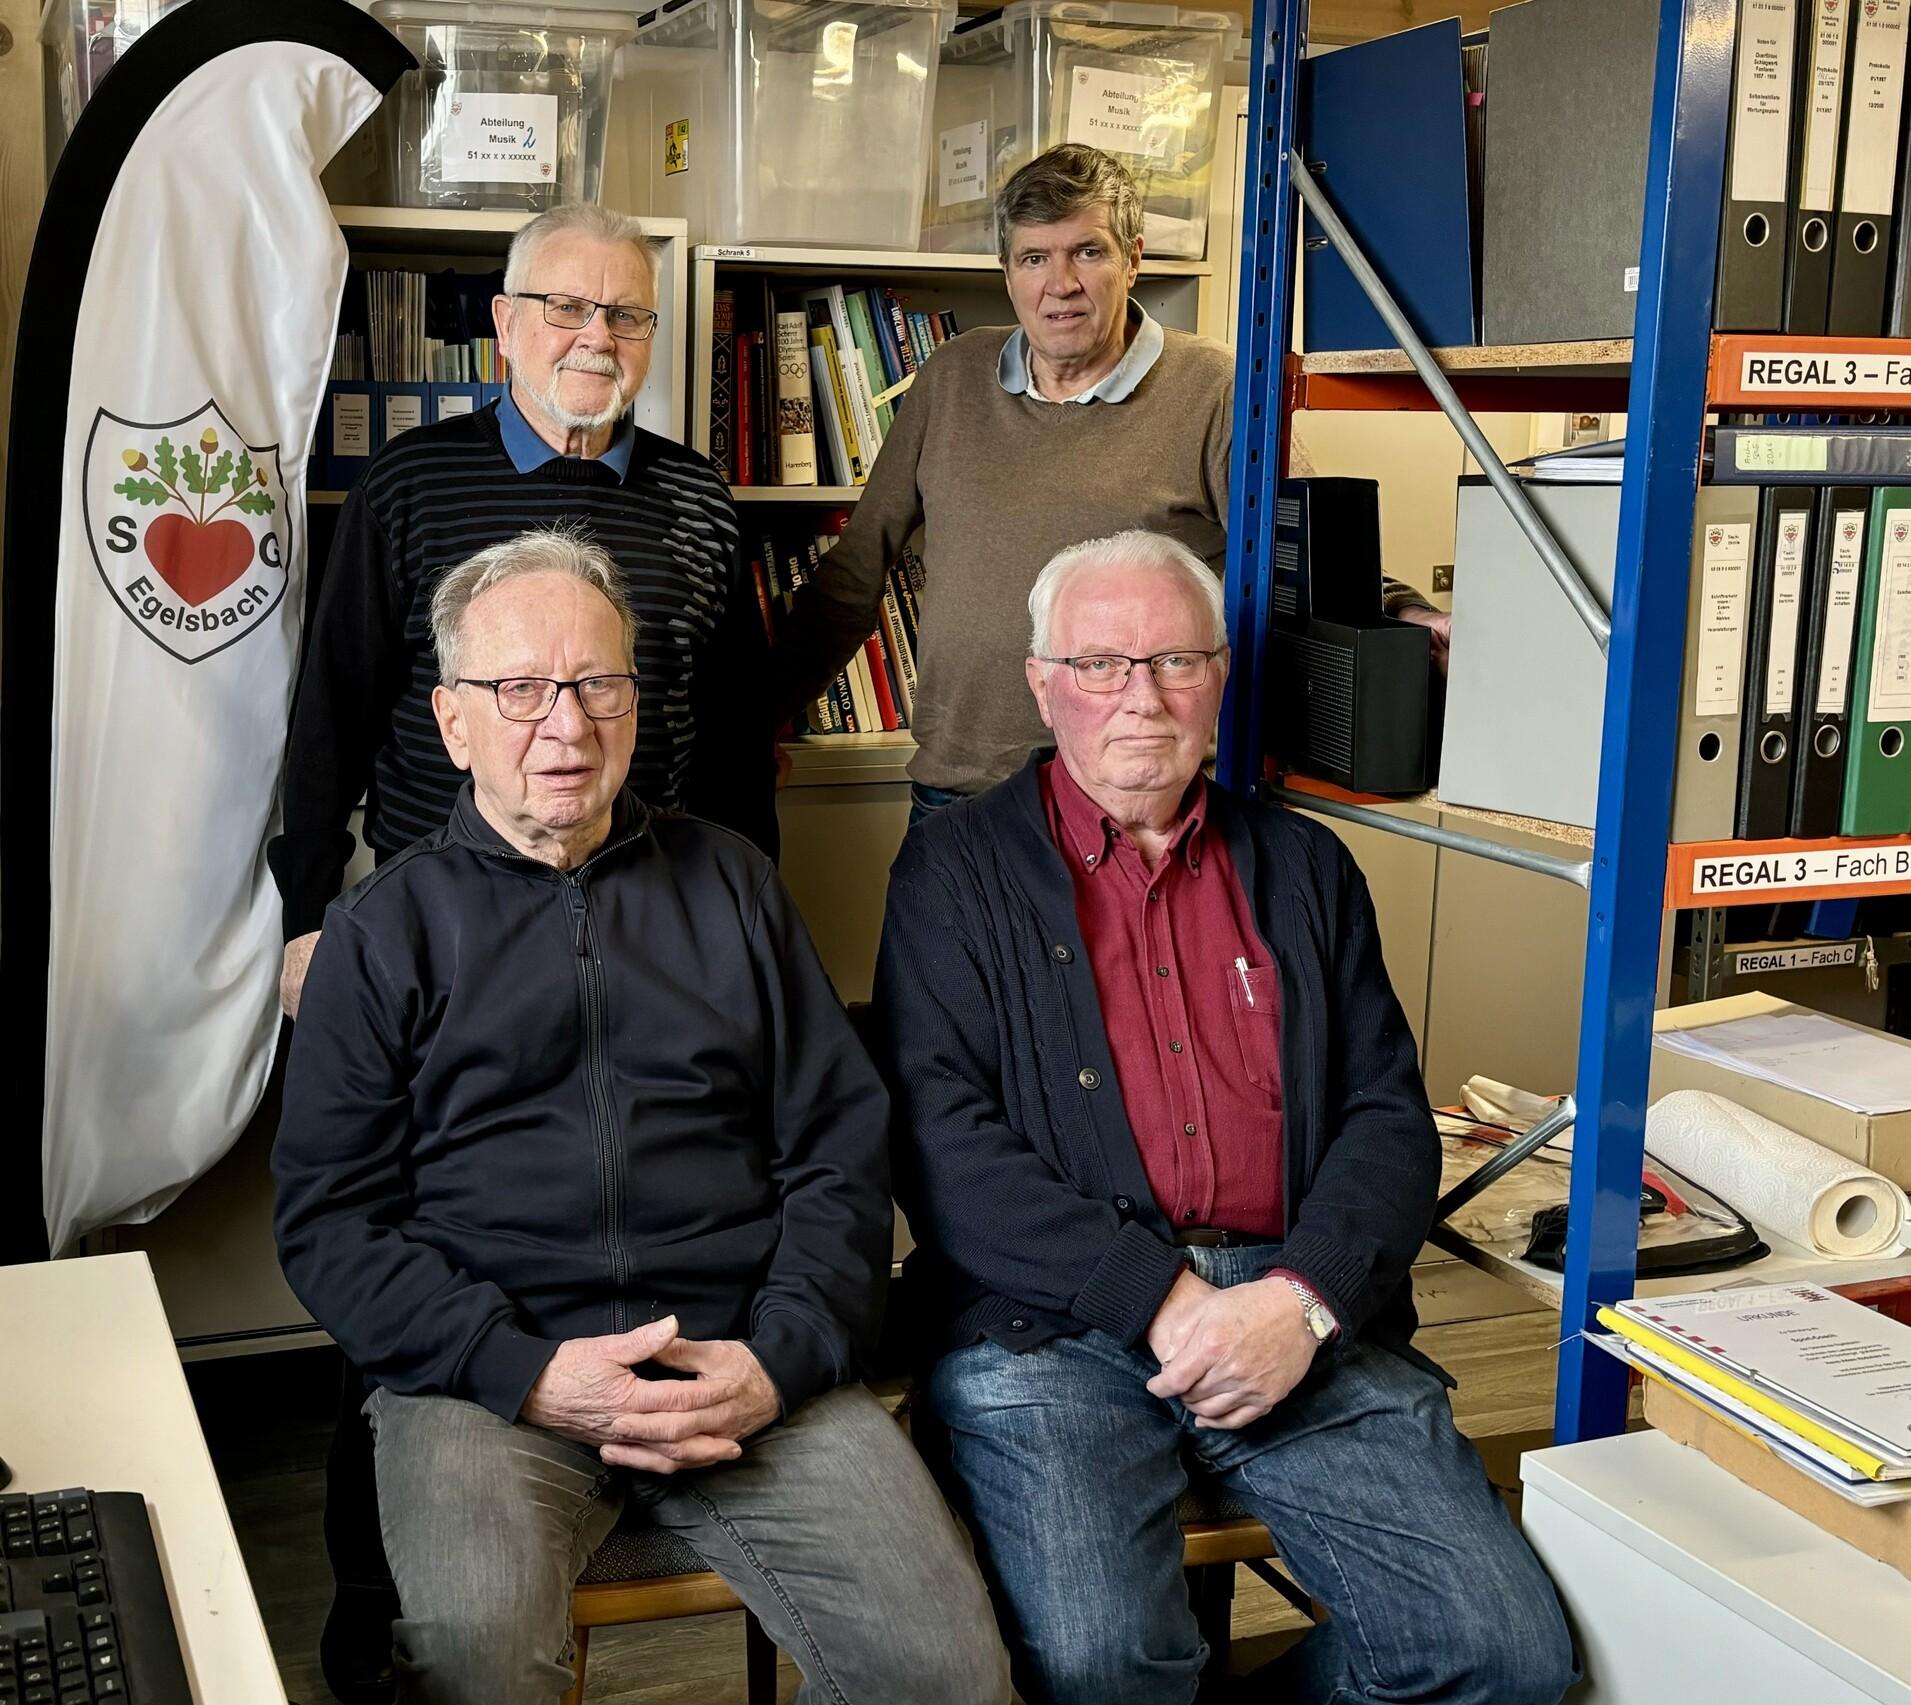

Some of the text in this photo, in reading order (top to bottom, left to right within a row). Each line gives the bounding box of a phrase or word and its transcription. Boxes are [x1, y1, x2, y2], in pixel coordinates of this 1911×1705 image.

[1107, 105, 1130, 116] Musik
[480, 117, 525, 129] Abteilung
[1089, 118, 1098, 126] 51
[488, 134, 516, 144] Musik
[523, 126, 536, 149] 2
[467, 150, 478, 160] 51
[717, 248, 751, 257] Schrank 5
[1748, 359, 1836, 385] REGAL
[1844, 360, 1857, 385] 3
[1886, 361, 1911, 385] Fa
[106, 515, 283, 569] S G
[125, 575, 269, 632] Egelsbach
[814, 696, 834, 731] Lingen
[1700, 859, 1786, 888] REGAL
[1794, 858, 1807, 881] 3
[1835, 852, 1888, 878] Fach
[1895, 851, 1909, 874] B
[1740, 955, 1786, 971] REGAL
[1790, 954, 1796, 967] 1
[1811, 950, 1840, 965] Fach
[1844, 948, 1853, 961] C
[1736, 1309, 1801, 1323] URKUNDE
